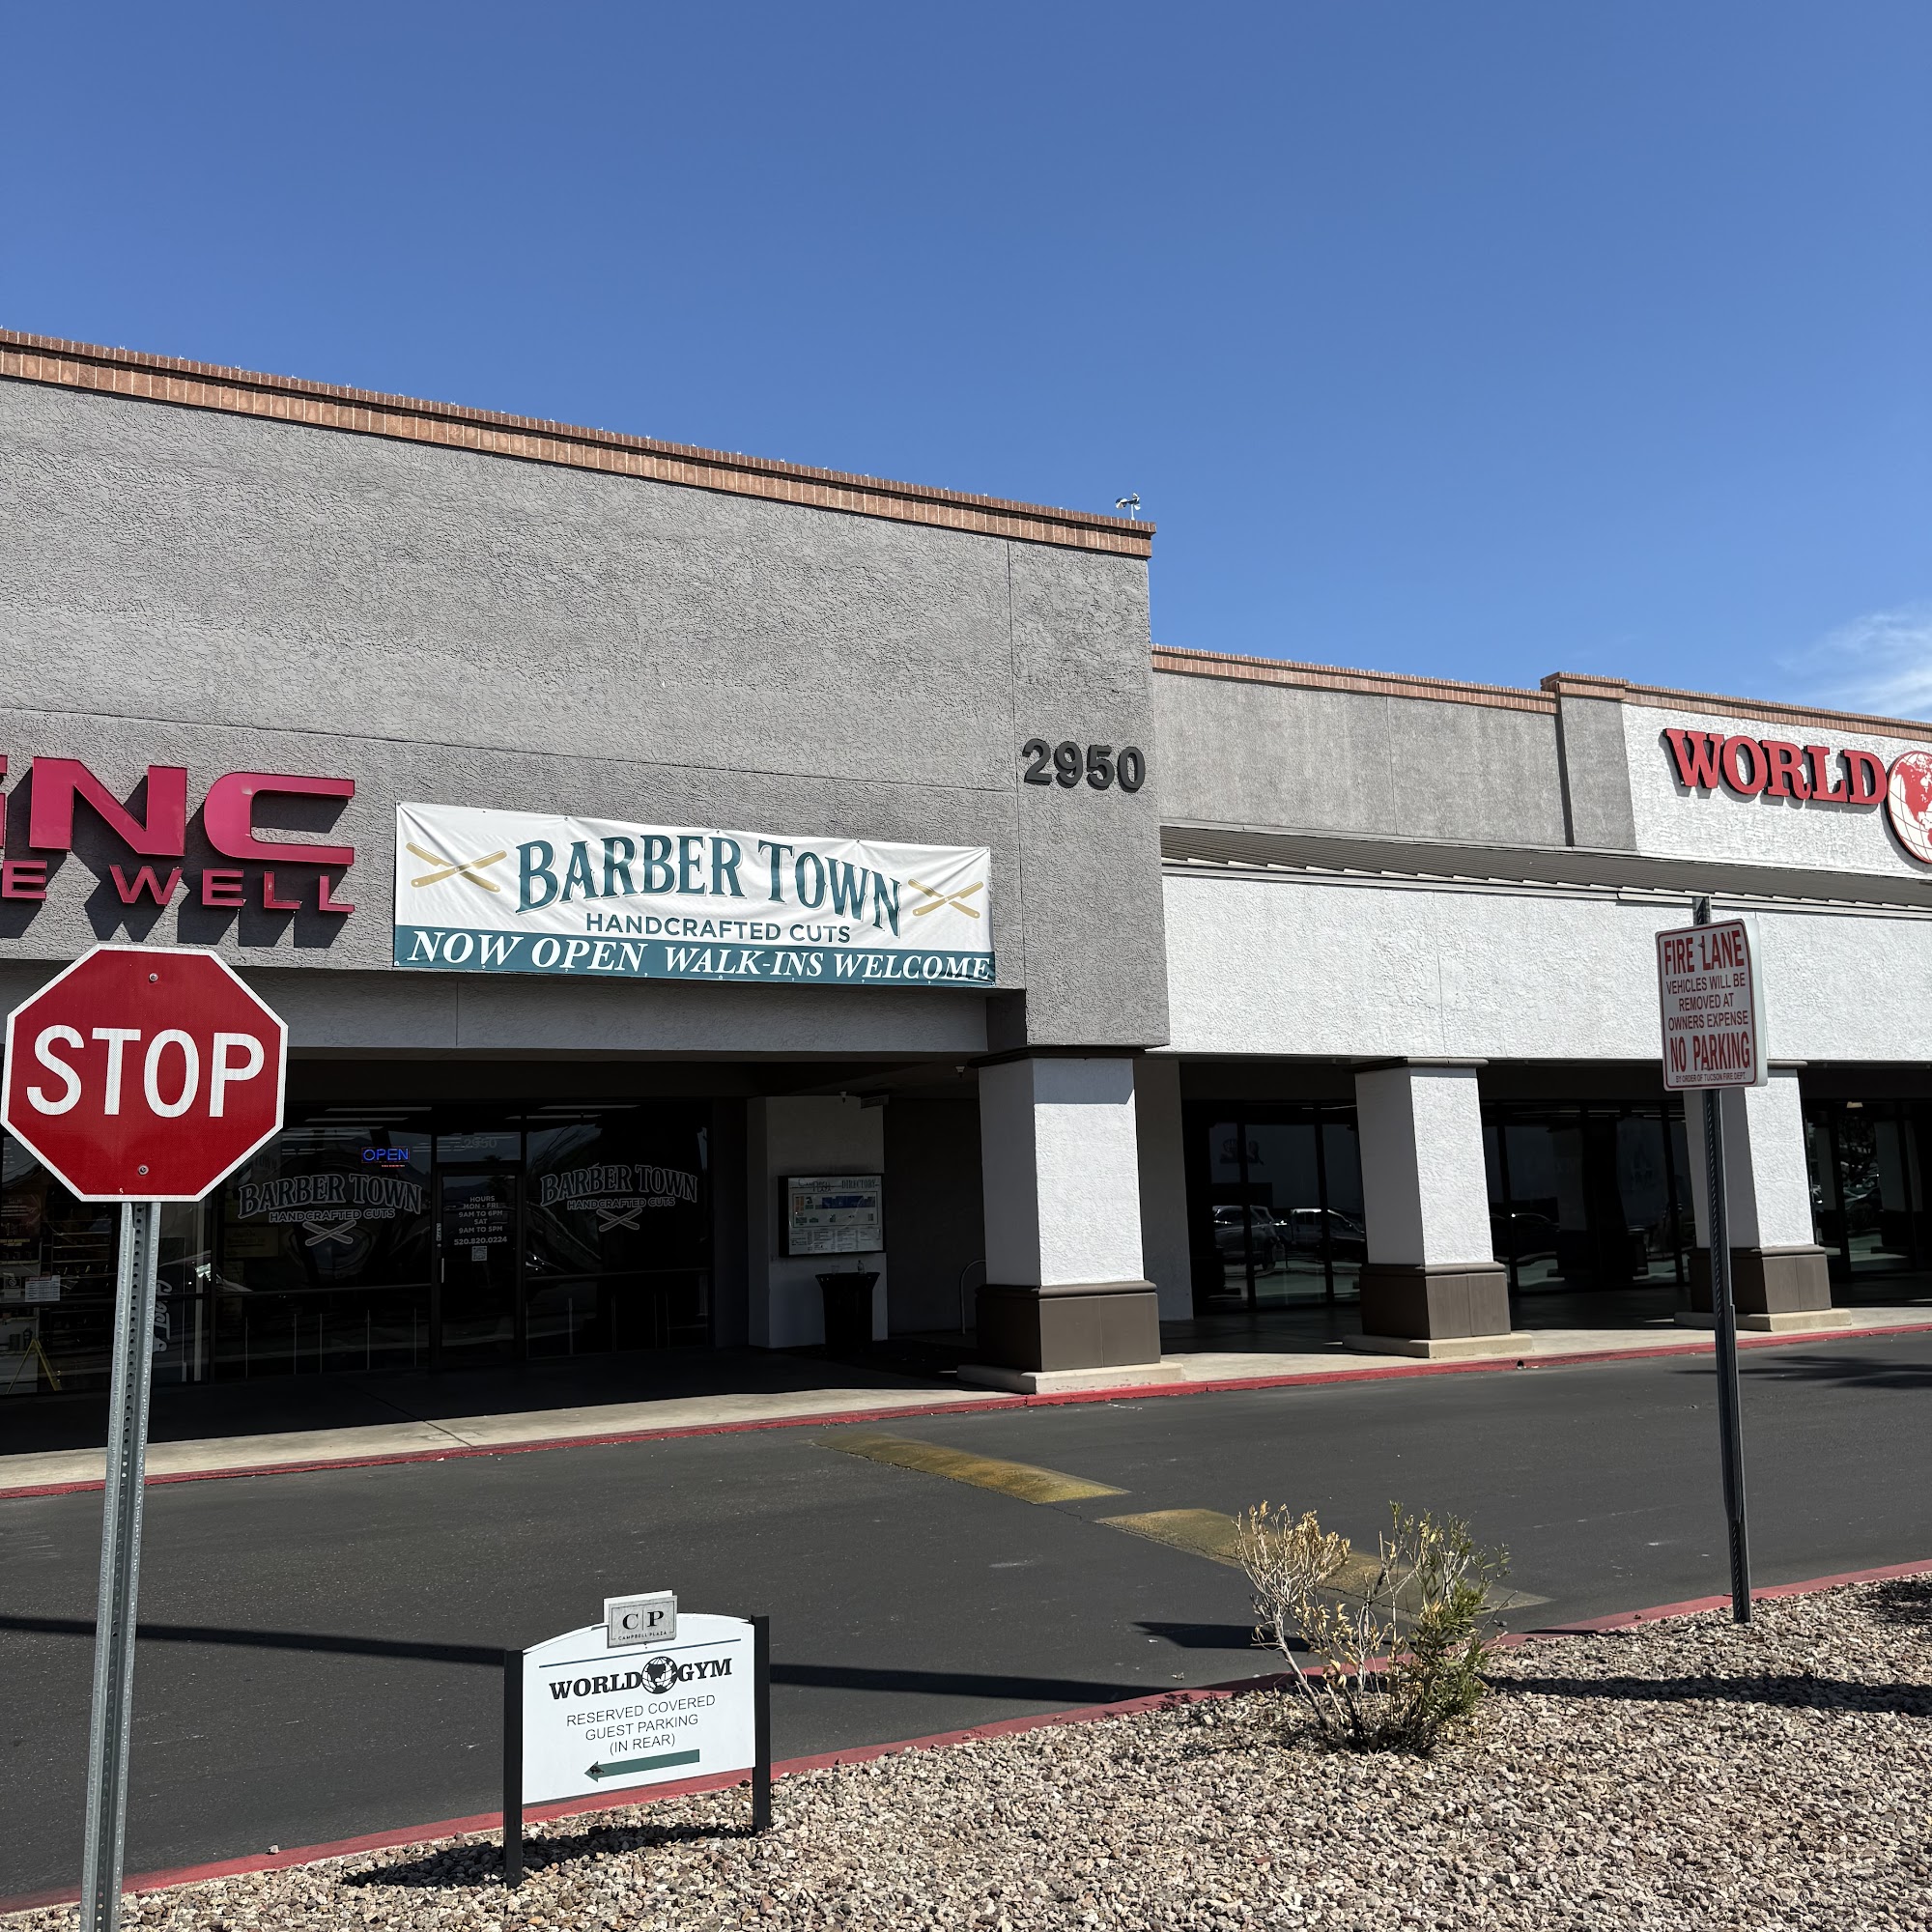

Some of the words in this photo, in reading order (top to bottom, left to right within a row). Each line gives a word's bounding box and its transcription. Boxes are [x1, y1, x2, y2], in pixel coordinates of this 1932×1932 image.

[1022, 737, 1146, 793] 2950
[1663, 727, 1888, 806] WORLD
[0, 754, 355, 867] NC
[109, 864, 355, 914] WELL
[515, 834, 745, 917] BARBER
[757, 839, 903, 939] TOWN
[585, 912, 781, 942] HANDCRAFTED
[789, 923, 851, 945] CUTS
[408, 929, 524, 967] NOW
[530, 935, 649, 972] OPEN
[666, 946, 824, 979] WALK-INS
[833, 952, 992, 981] WELCOME
[1663, 936, 1695, 976] FIRE
[1701, 929, 1745, 971] LANE
[1665, 976, 1708, 995] VEHICLES
[1709, 974, 1731, 990] WILL
[1733, 972, 1746, 987] BE
[1678, 994, 1720, 1011] REMOVED
[1722, 992, 1734, 1008] AT
[1668, 1013, 1705, 1031] OWNERS
[1707, 1009, 1748, 1028] EXPENSE
[1669, 1036, 1687, 1073] NO
[1692, 1030, 1750, 1071] PARKING
[26, 1024, 265, 1119] STOP
[1682, 1074, 1696, 1083] ORDER
[1697, 1073, 1703, 1082] OF
[1704, 1073, 1723, 1082] TUCSON
[1723, 1072, 1733, 1081] FIRE
[362, 1148, 409, 1162] OPEN
[238, 1173, 347, 1219] BARBER
[349, 1173, 422, 1214] TOWN
[540, 1165, 633, 1208] BARBER
[635, 1164, 697, 1203] TOWN
[567, 1198, 647, 1210] HANDCRAFTED
[648, 1197, 676, 1208] CUTS
[269, 1209, 361, 1222] HANDCRAFTED
[361, 1208, 396, 1219] CUTS
[618, 1633, 647, 1641] CAMPBELL
[549, 1670, 643, 1700] WORLD
[676, 1658, 732, 1682] GYM
[566, 1704, 643, 1727] RESERVED
[648, 1694, 716, 1715] COVERED
[585, 1722, 635, 1741] GUEST
[638, 1714, 698, 1733] PARKING
[609, 1741, 628, 1756] (IN
[633, 1732, 675, 1751] REAR)
